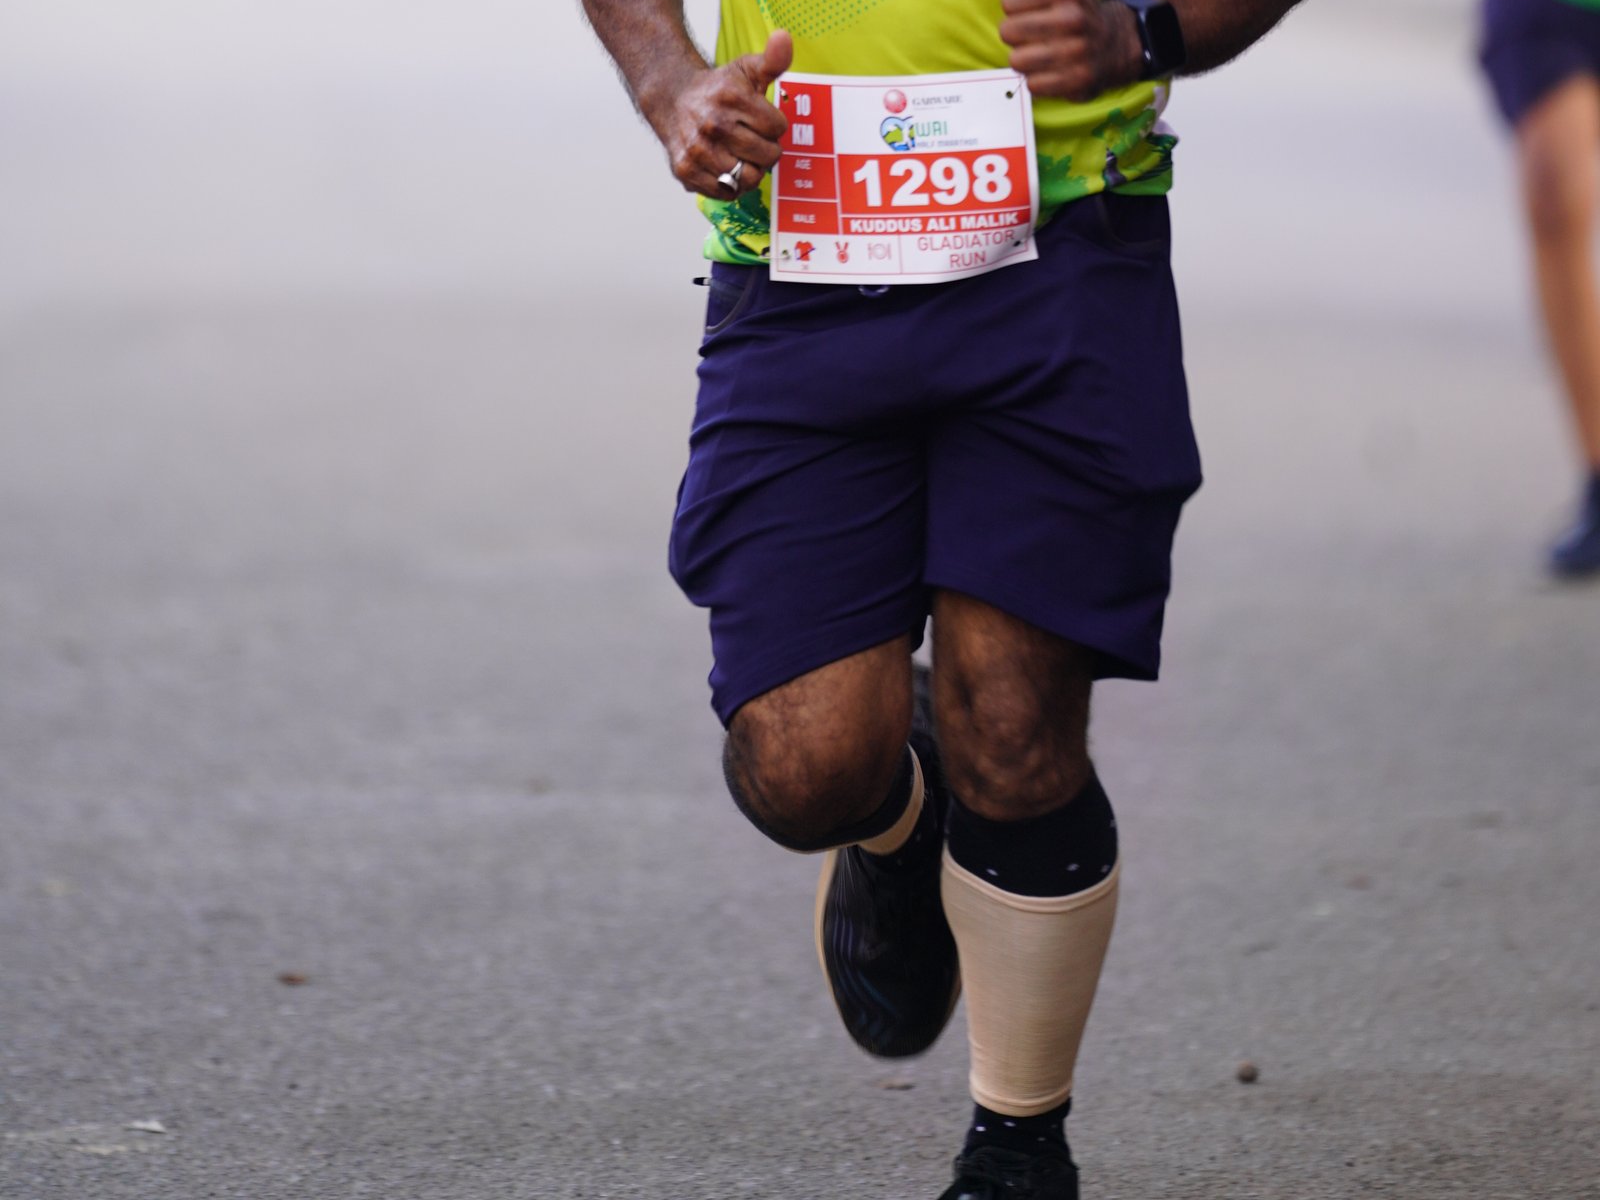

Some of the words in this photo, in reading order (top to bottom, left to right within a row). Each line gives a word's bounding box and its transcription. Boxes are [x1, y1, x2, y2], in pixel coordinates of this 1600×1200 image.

[794, 93, 812, 116] 10
[915, 120, 949, 138] WAI
[853, 154, 1013, 207] 1298
[850, 218, 922, 233] KUDDUS
[926, 217, 956, 231] ALI
[960, 212, 1018, 230] MALIK
[917, 229, 1016, 252] GLADIATOR
[950, 250, 987, 268] RUN
